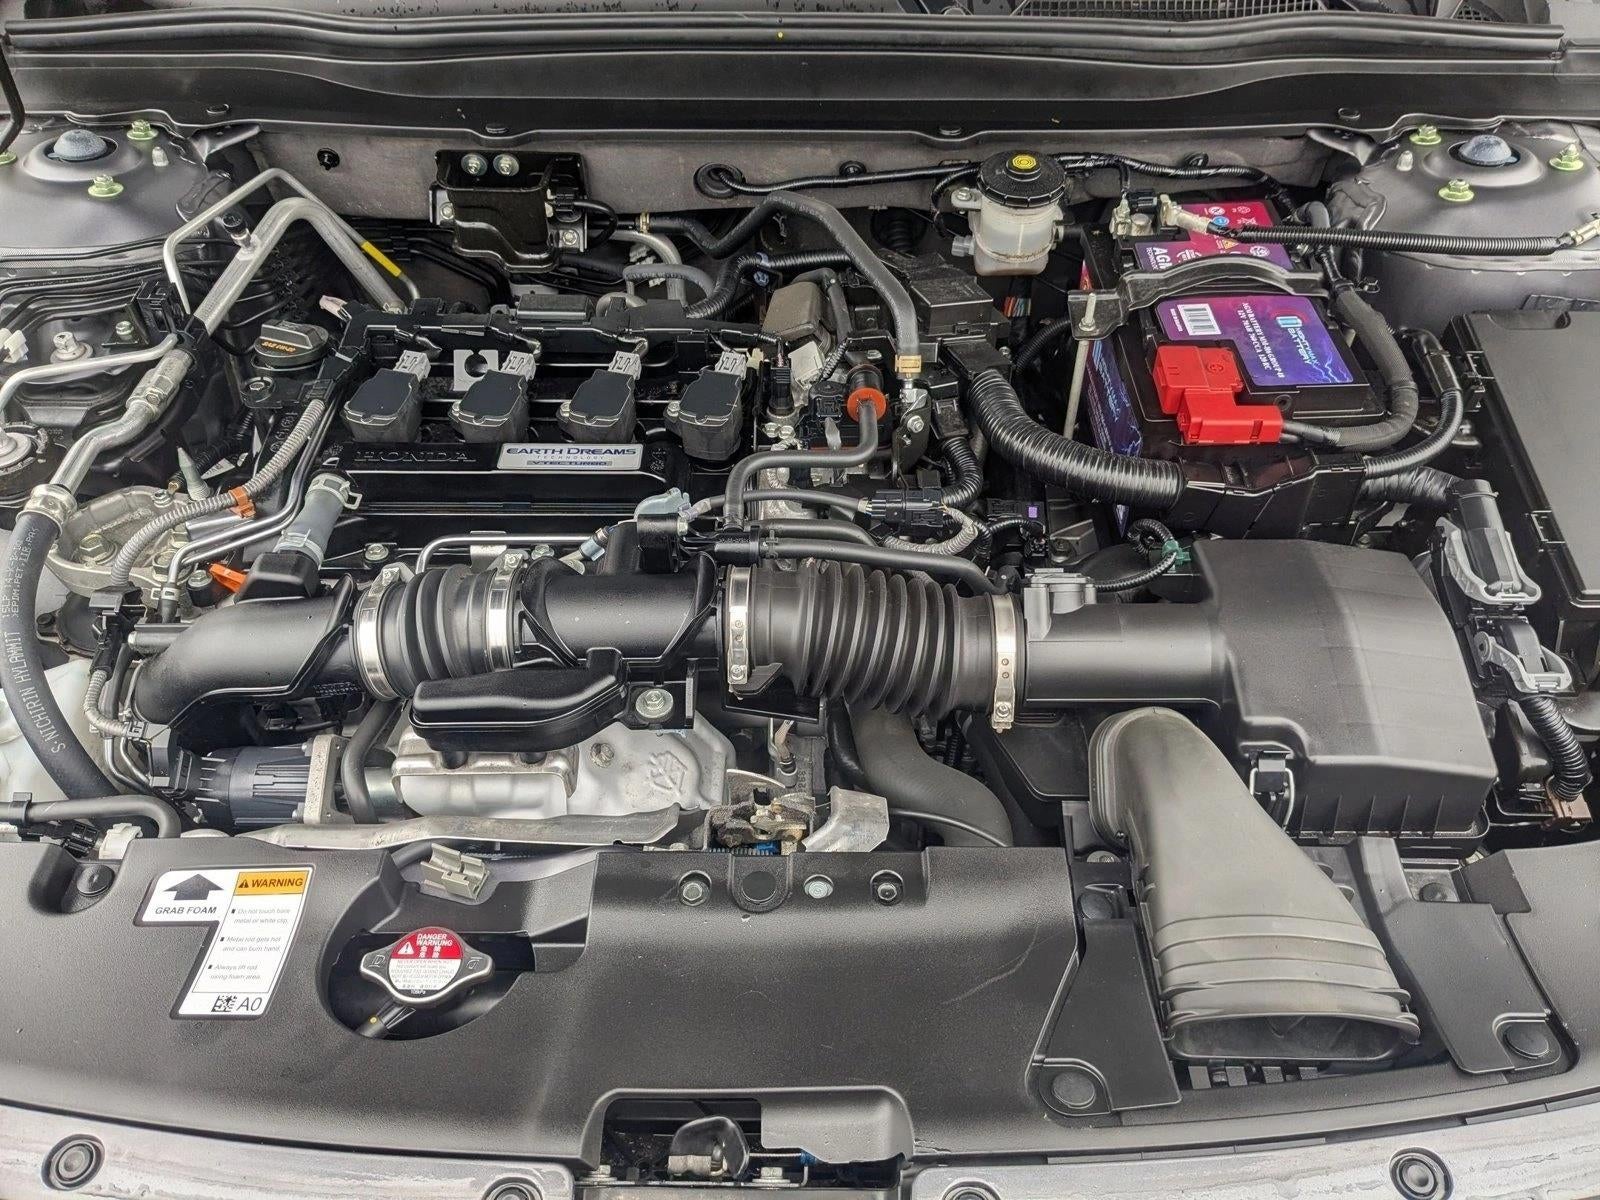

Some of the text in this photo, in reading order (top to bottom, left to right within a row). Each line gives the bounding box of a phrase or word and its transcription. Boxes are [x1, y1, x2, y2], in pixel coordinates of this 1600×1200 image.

[506, 447, 637, 455] EARTH DREAMS
[354, 451, 476, 462] HONDA
[251, 878, 304, 888] WARNING
[155, 906, 217, 915] GRAB FOAM
